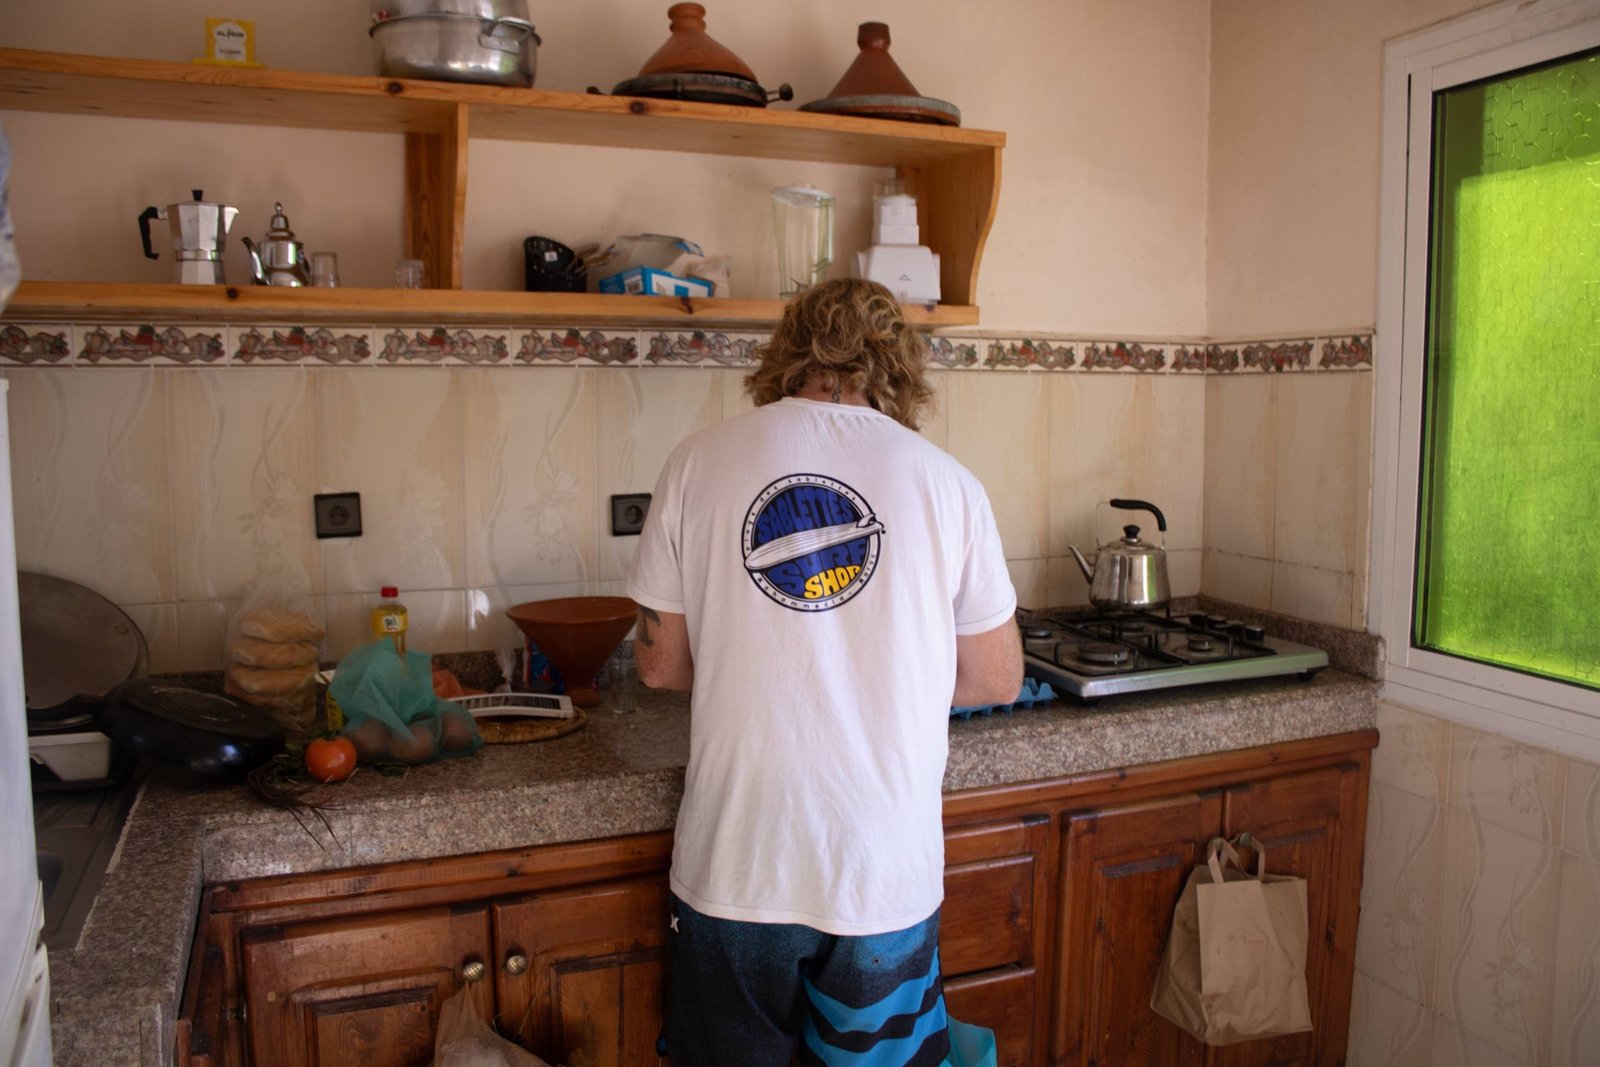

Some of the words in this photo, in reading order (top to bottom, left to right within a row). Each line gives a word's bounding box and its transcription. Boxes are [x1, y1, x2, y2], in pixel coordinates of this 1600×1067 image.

[757, 486, 854, 544] SABLETTES
[768, 538, 867, 598] SURF
[803, 565, 861, 600] SHOP
